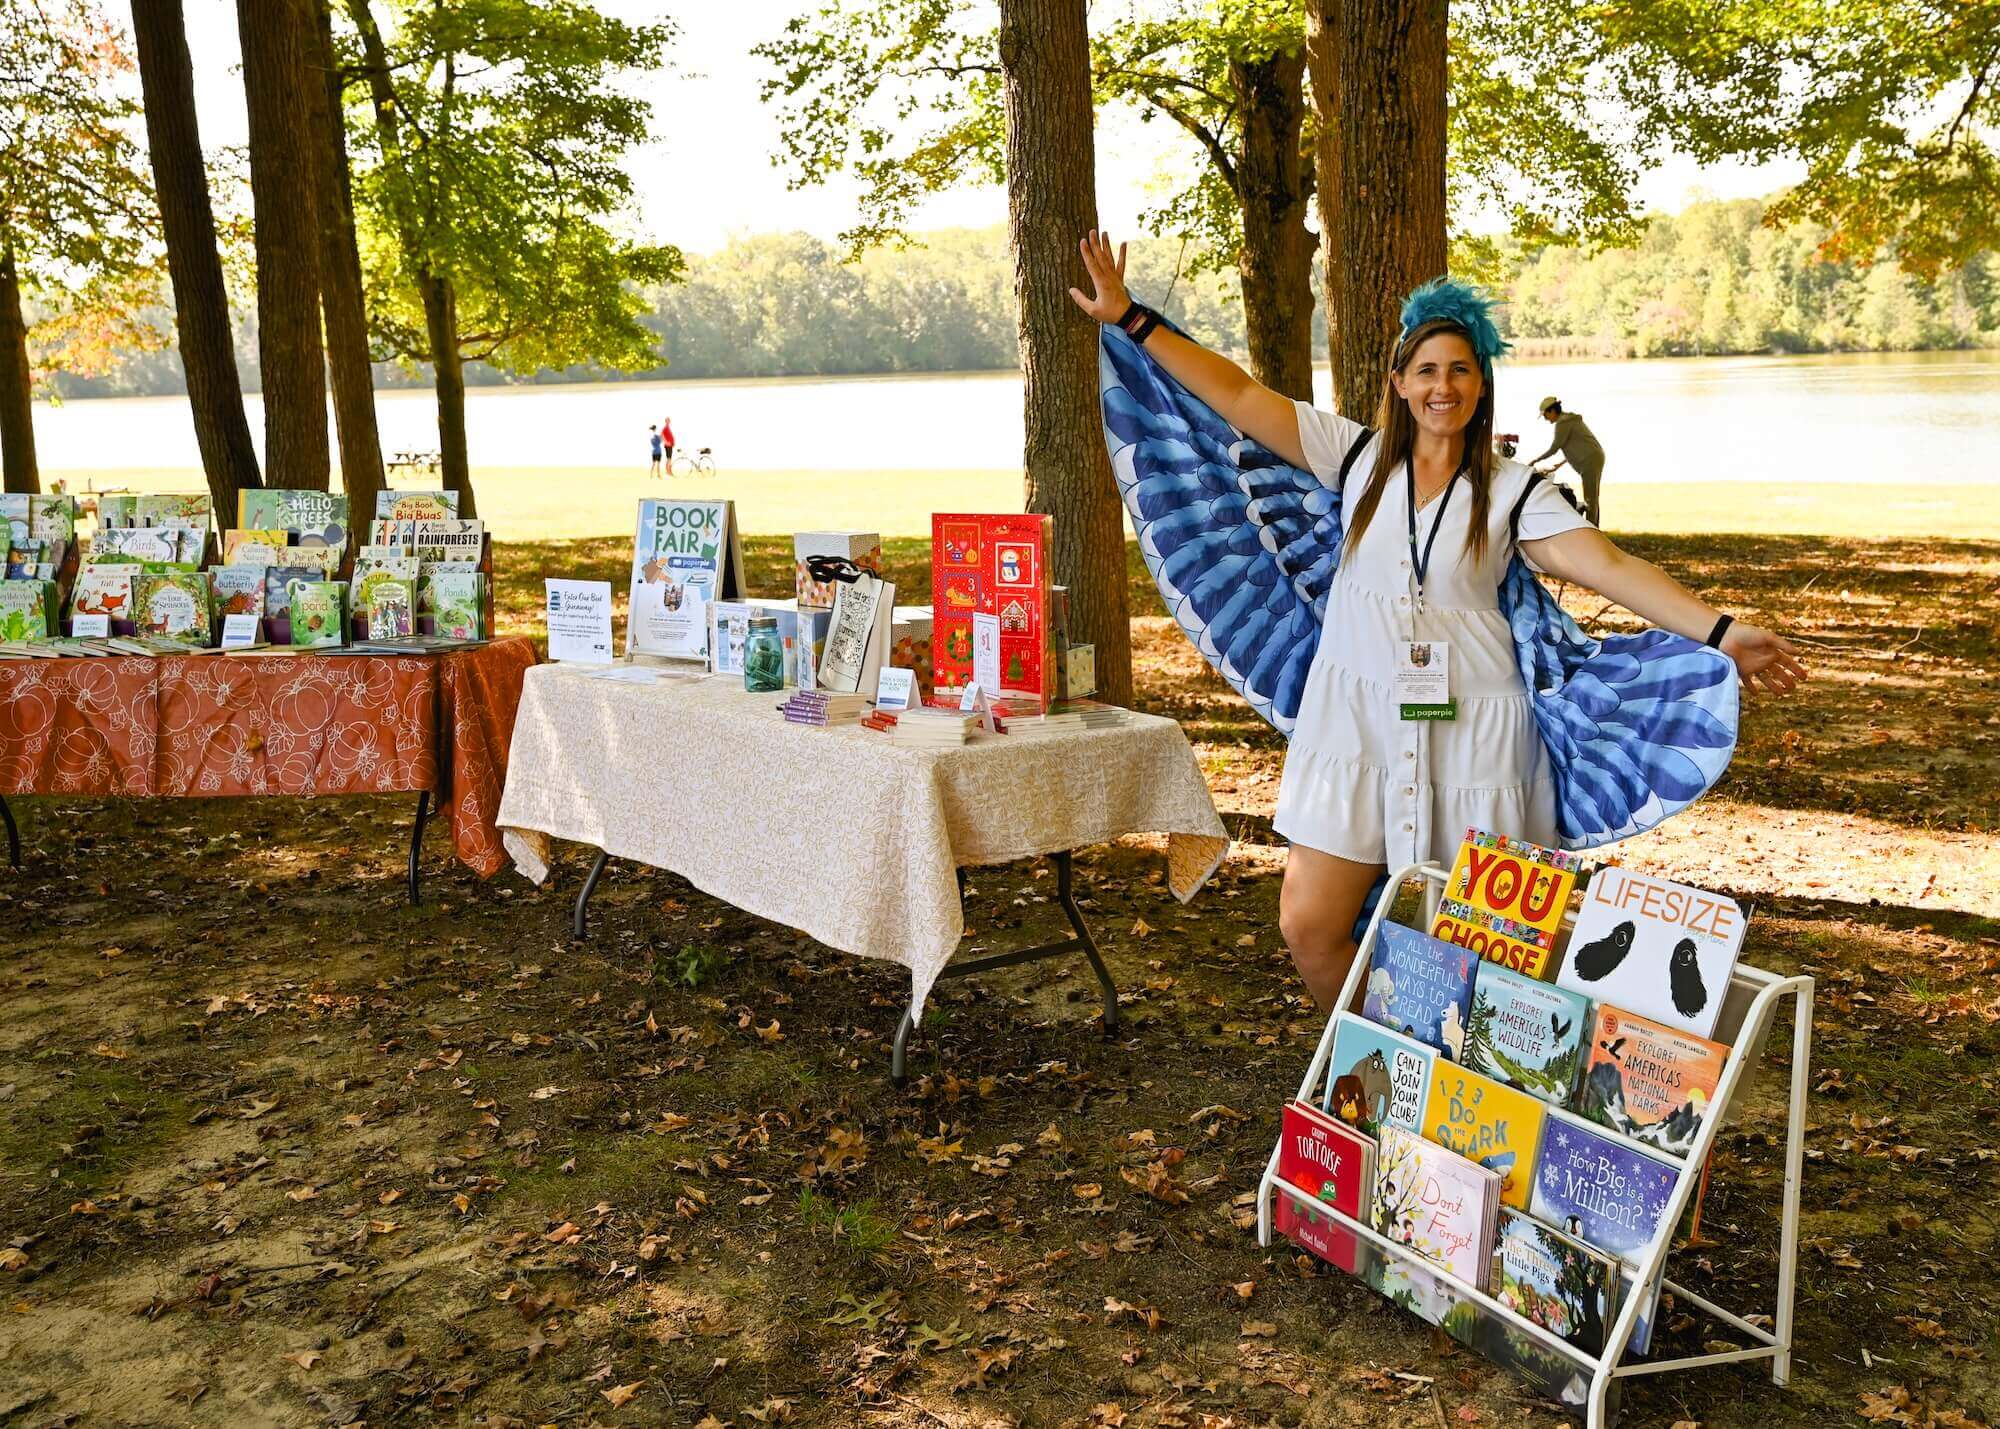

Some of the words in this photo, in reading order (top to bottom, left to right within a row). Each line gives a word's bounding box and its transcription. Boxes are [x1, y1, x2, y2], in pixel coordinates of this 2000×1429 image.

[294, 496, 332, 511] HELLO
[402, 501, 413, 509] Big
[415, 501, 433, 509] Book
[292, 511, 332, 524] TREES
[656, 506, 718, 528] BOOK
[130, 538, 157, 551] Birds
[419, 534, 479, 545] RAINFORESTS
[1022, 549, 1030, 560] 8
[218, 580, 255, 590] butterfly
[444, 585, 468, 597] Ponds
[968, 578, 975, 592] 3
[302, 600, 328, 611] pond
[1024, 601, 1033, 610] 17
[957, 642, 967, 652] 21
[1021, 650, 1031, 660] 10
[1417, 709, 1453, 718] paperpie
[1463, 848, 1563, 922] YOU
[1595, 872, 1737, 939] LIFESIZE
[1407, 939, 1423, 955] ALL
[1389, 945, 1457, 991] WONDERFUL
[1395, 970, 1426, 998] WAYS
[1398, 995, 1433, 1024] READ
[1510, 998, 1543, 1019] EXPLORE!
[1498, 1011, 1547, 1040] AMERICA'S
[1498, 1028, 1543, 1058] WILDLIFE
[1637, 1040, 1677, 1064] EXPLORE!
[1397, 1052, 1415, 1071] CAN
[1416, 1060, 1422, 1075] I
[1624, 1054, 1681, 1088] AMERICA'S
[1393, 1070, 1420, 1089] JOIN
[1628, 1076, 1670, 1103] NATIONAL
[1392, 1084, 1418, 1107] YOUR
[1440, 1080, 1446, 1096] 1
[1456, 1080, 1464, 1097] 2
[1472, 1088, 1483, 1104] 3
[1390, 1102, 1417, 1125] CLUB?
[1632, 1095, 1660, 1115] PARKS
[1437, 1120, 1509, 1156] SHARK
[1296, 1135, 1342, 1177] TORTOISE
[1567, 1148, 1596, 1174] How
[1595, 1156, 1626, 1197] Big
[1627, 1179, 1636, 1199] is
[1637, 1192, 1645, 1202] a
[1560, 1169, 1644, 1231] Million?
[1427, 1211, 1473, 1256] Forget
[1504, 1238, 1525, 1257] The
[1525, 1250, 1558, 1276] Three
[1506, 1252, 1530, 1273] Little
[1531, 1267, 1551, 1284] Pigs
